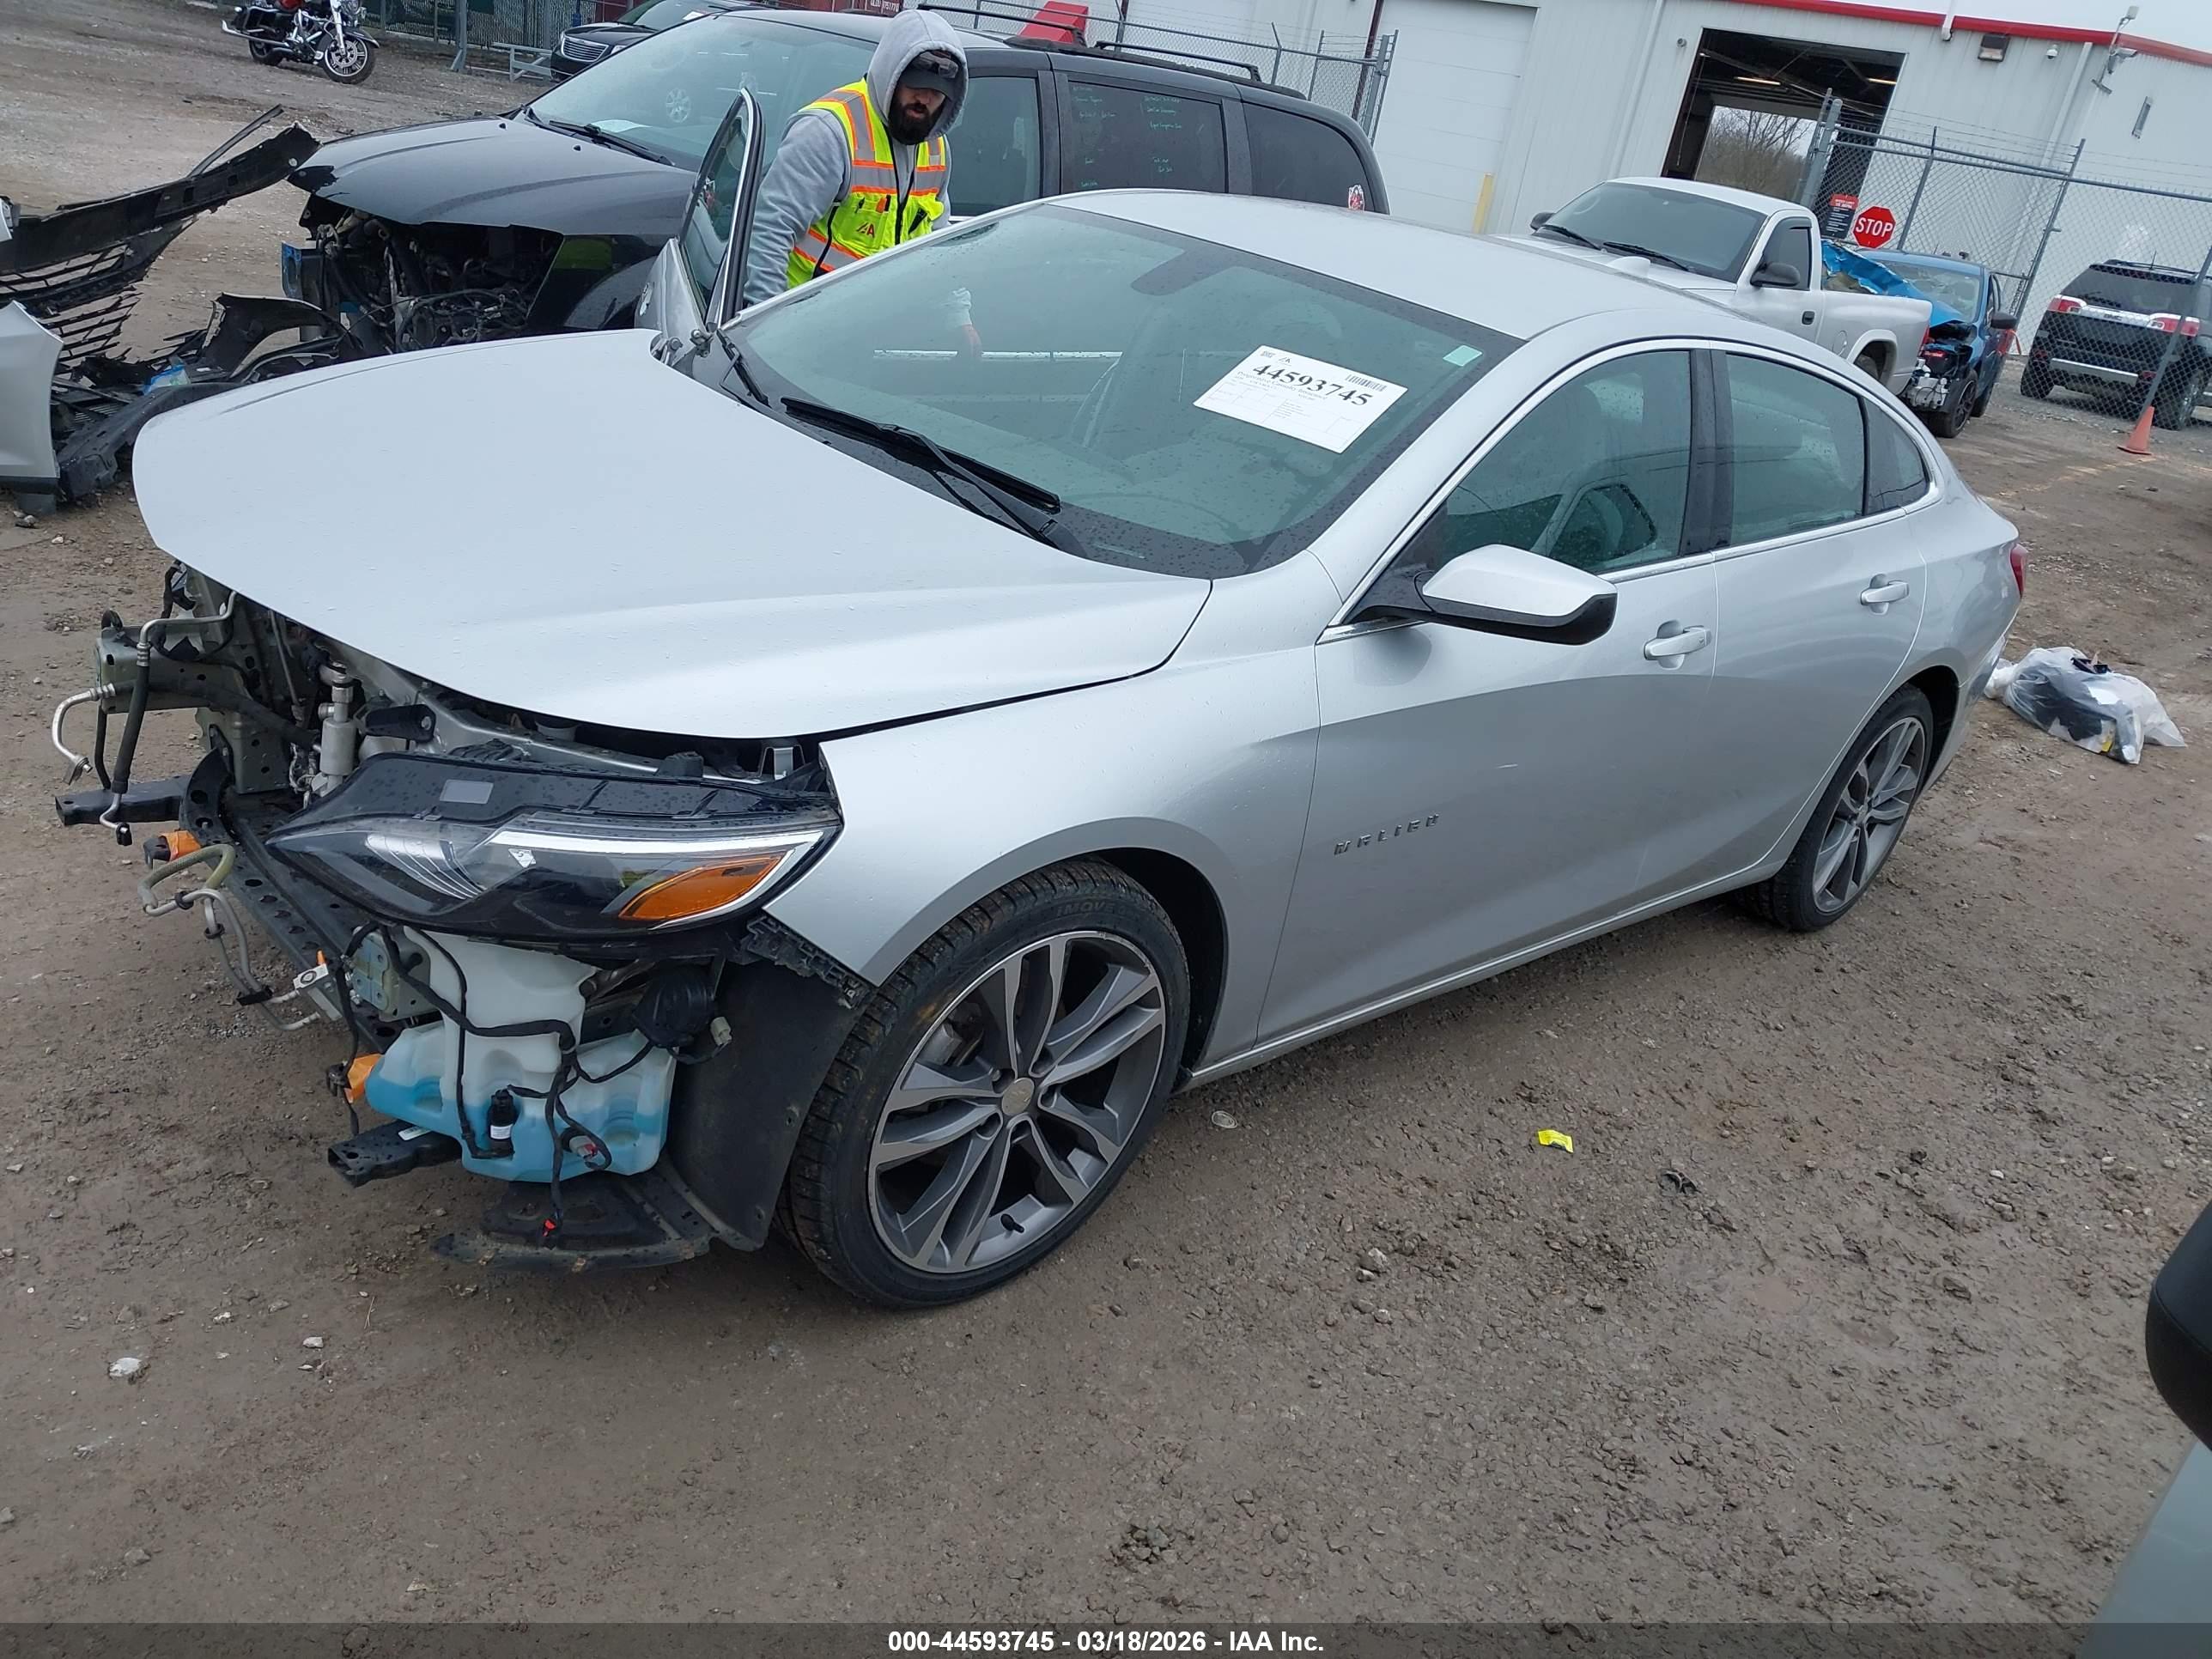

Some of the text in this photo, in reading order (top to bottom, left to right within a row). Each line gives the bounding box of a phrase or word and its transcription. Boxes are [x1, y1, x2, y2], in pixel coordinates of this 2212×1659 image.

[1856, 216, 1893, 238] STOP
[1253, 364, 1374, 406] 44593745
[1334, 813, 1440, 855] MALIBU
